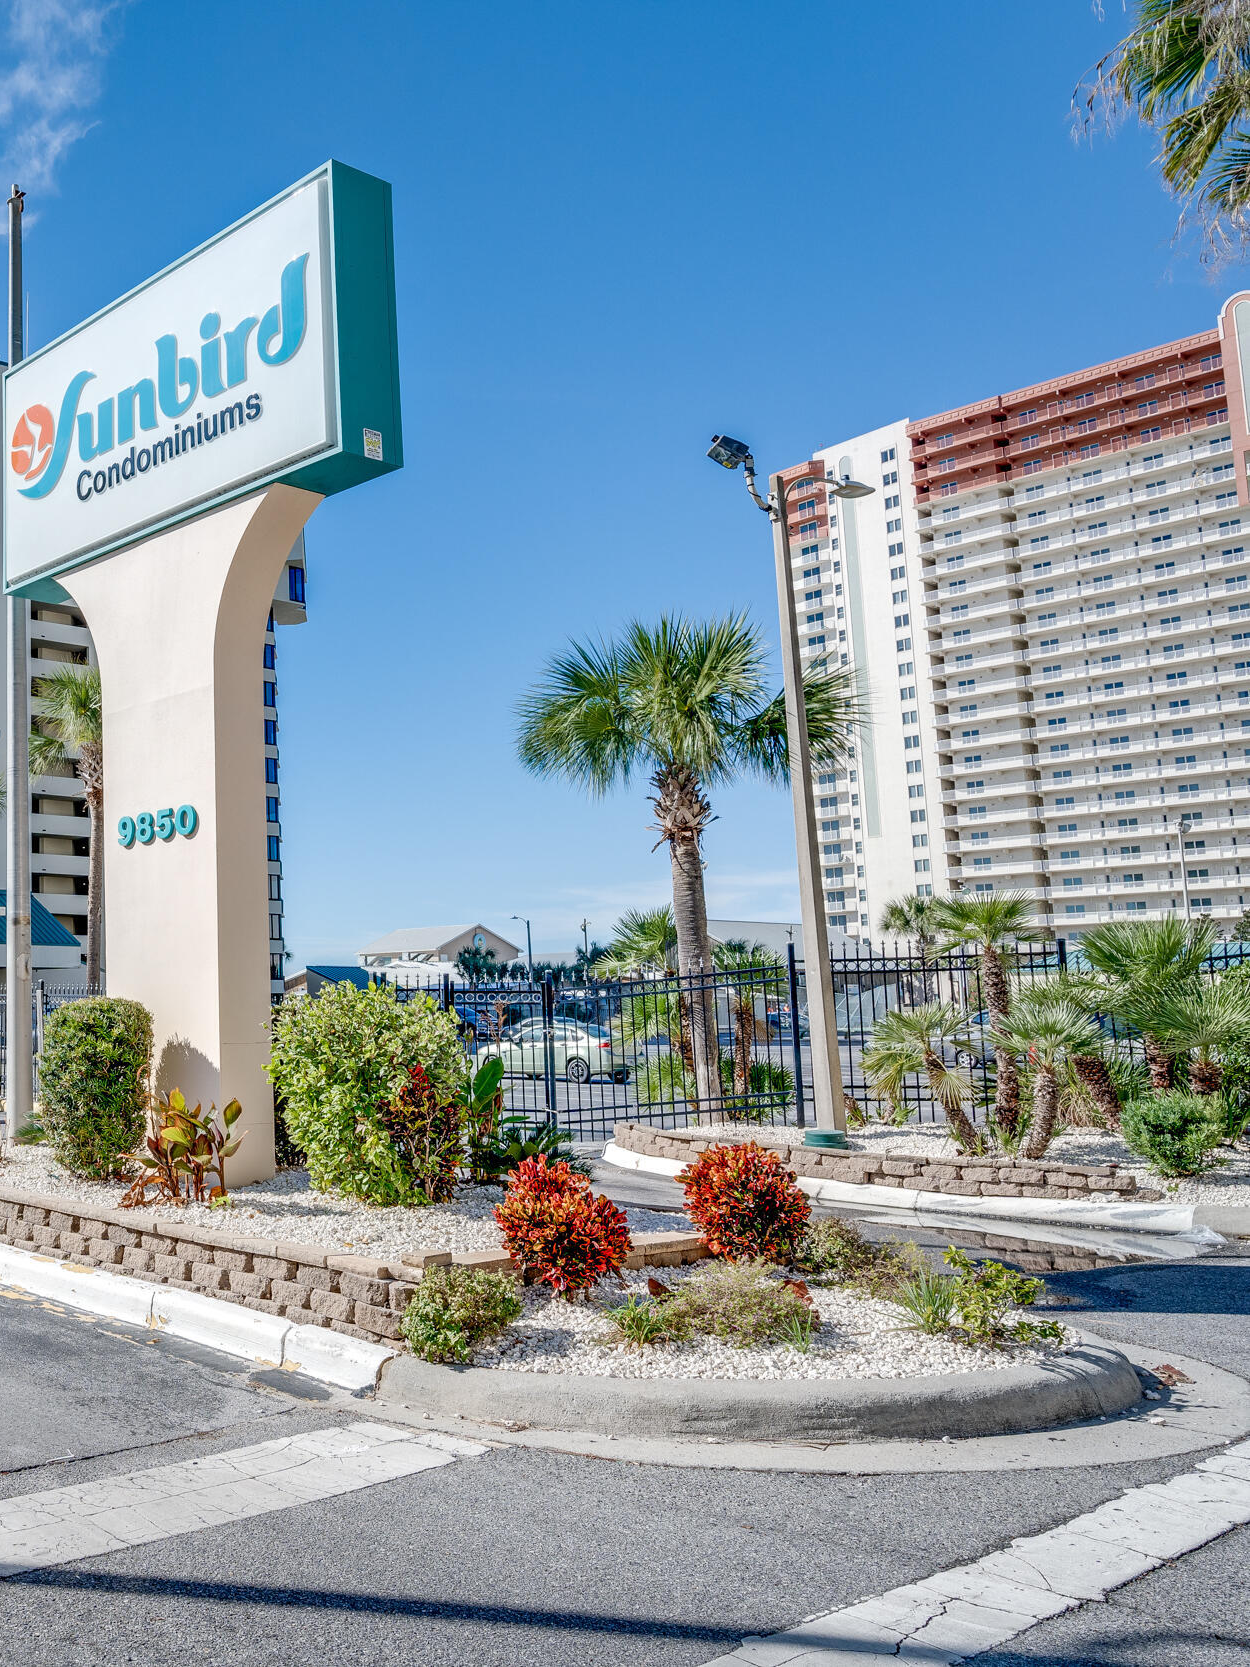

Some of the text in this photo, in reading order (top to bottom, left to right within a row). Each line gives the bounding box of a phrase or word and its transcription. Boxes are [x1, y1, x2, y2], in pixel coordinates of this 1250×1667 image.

[16, 252, 310, 499] Sunbird
[76, 392, 263, 502] Condominiums
[117, 804, 198, 847] 9850
